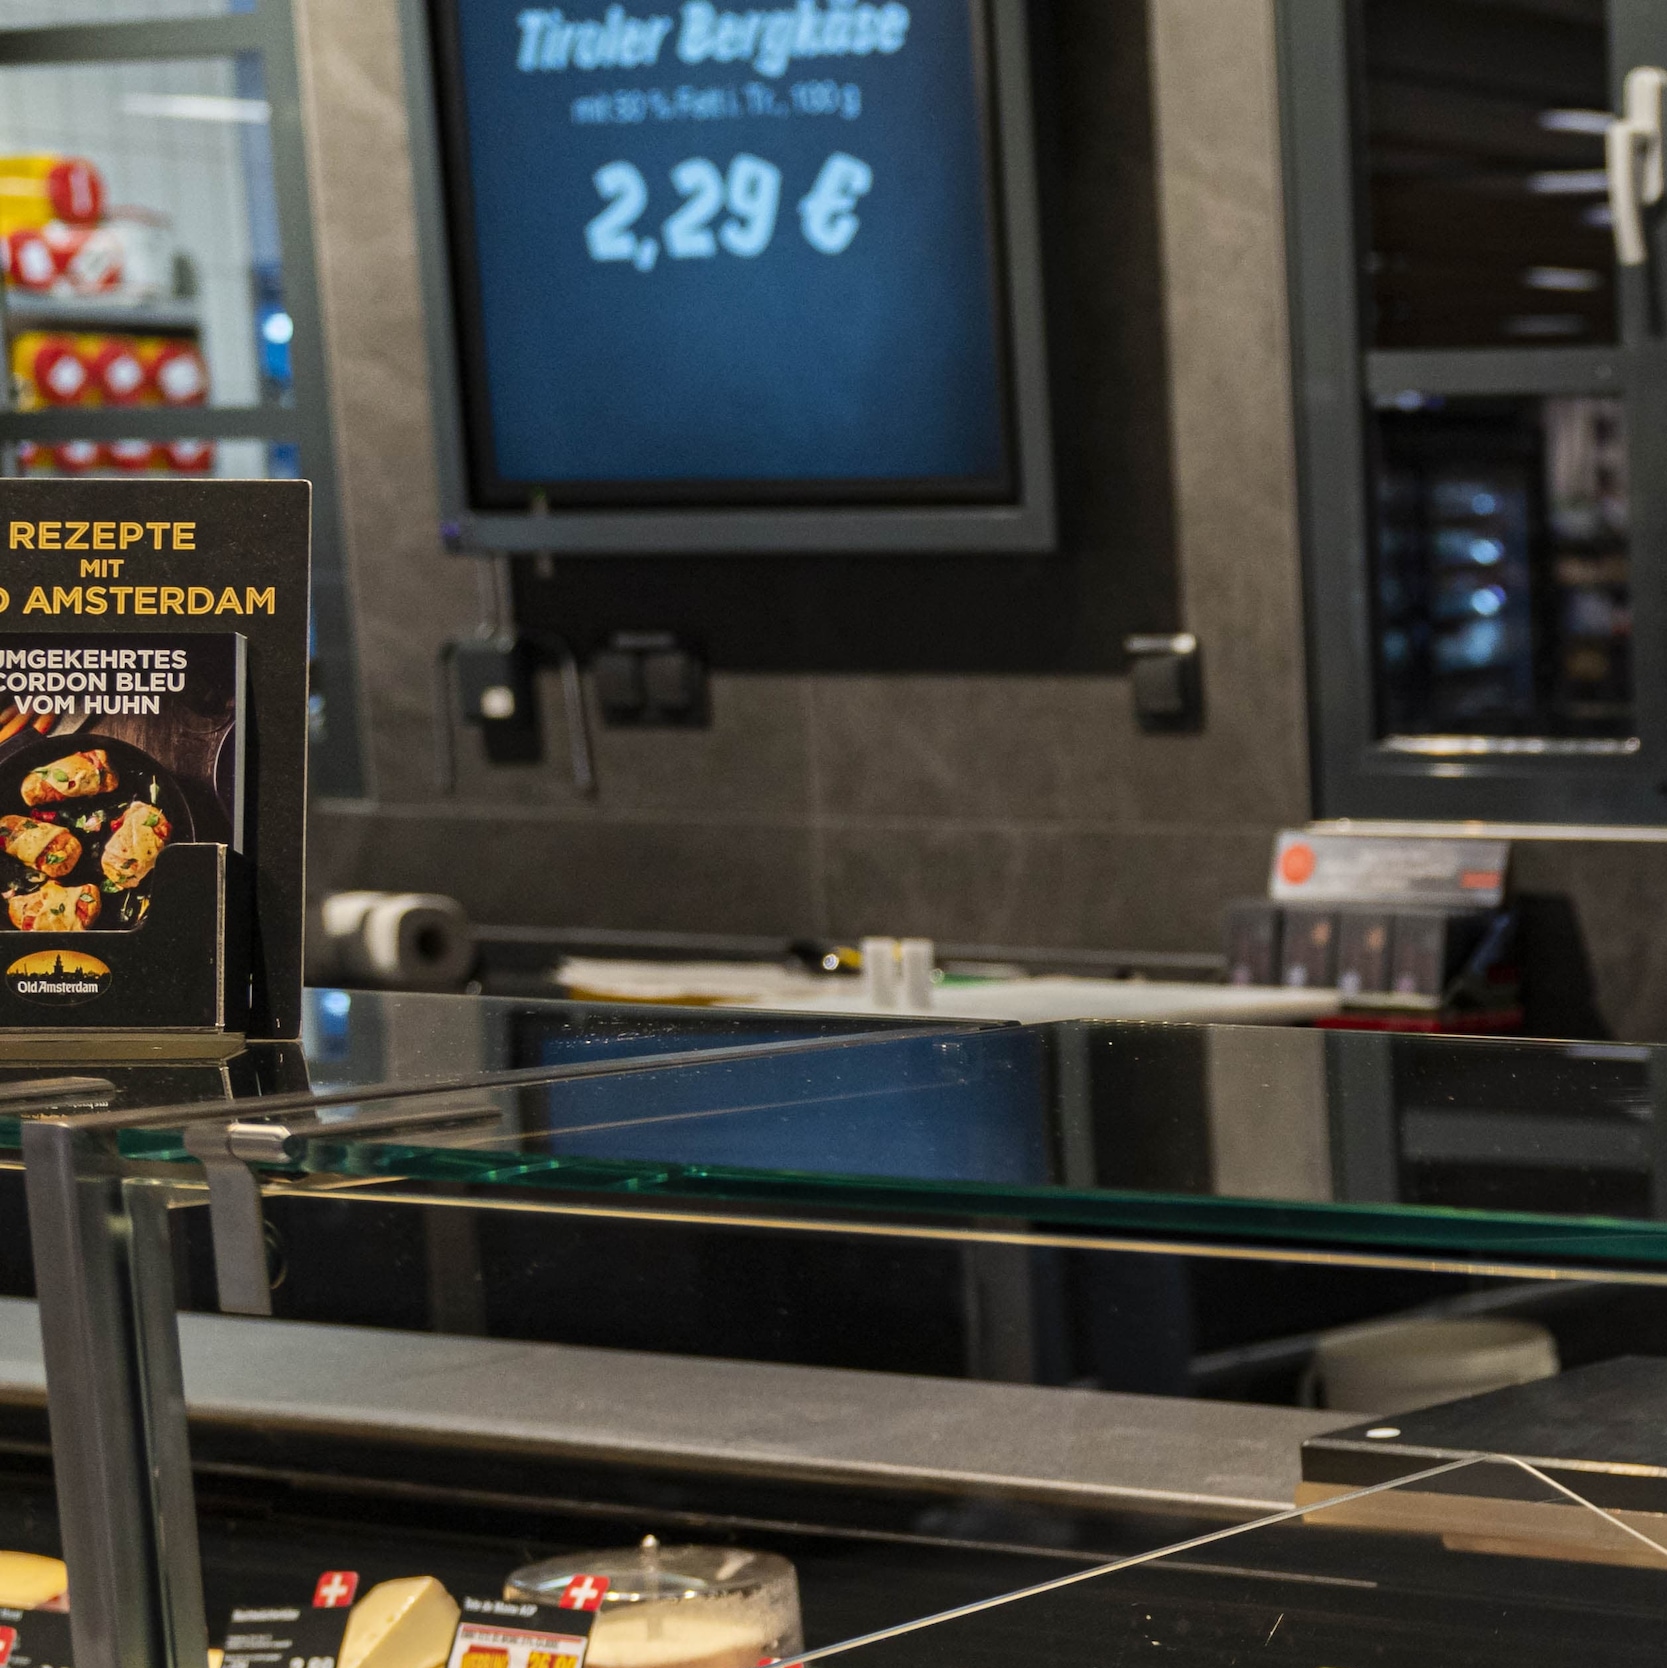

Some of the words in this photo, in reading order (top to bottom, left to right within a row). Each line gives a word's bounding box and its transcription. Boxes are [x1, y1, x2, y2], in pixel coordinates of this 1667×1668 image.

[516, 3, 673, 72] Tiroler
[676, 0, 910, 78] Bergkäse
[584, 152, 781, 272] 2,29
[798, 152, 873, 254] €
[9, 521, 196, 550] REZEPTE
[80, 559, 124, 578] MIT
[22, 586, 276, 615] AMSTERDAM
[116, 672, 186, 692] BLEU
[14, 695, 75, 715] VOM
[84, 695, 160, 715] HUHN
[17, 981, 37, 994] Old
[38, 981, 98, 993] Amsterdam
